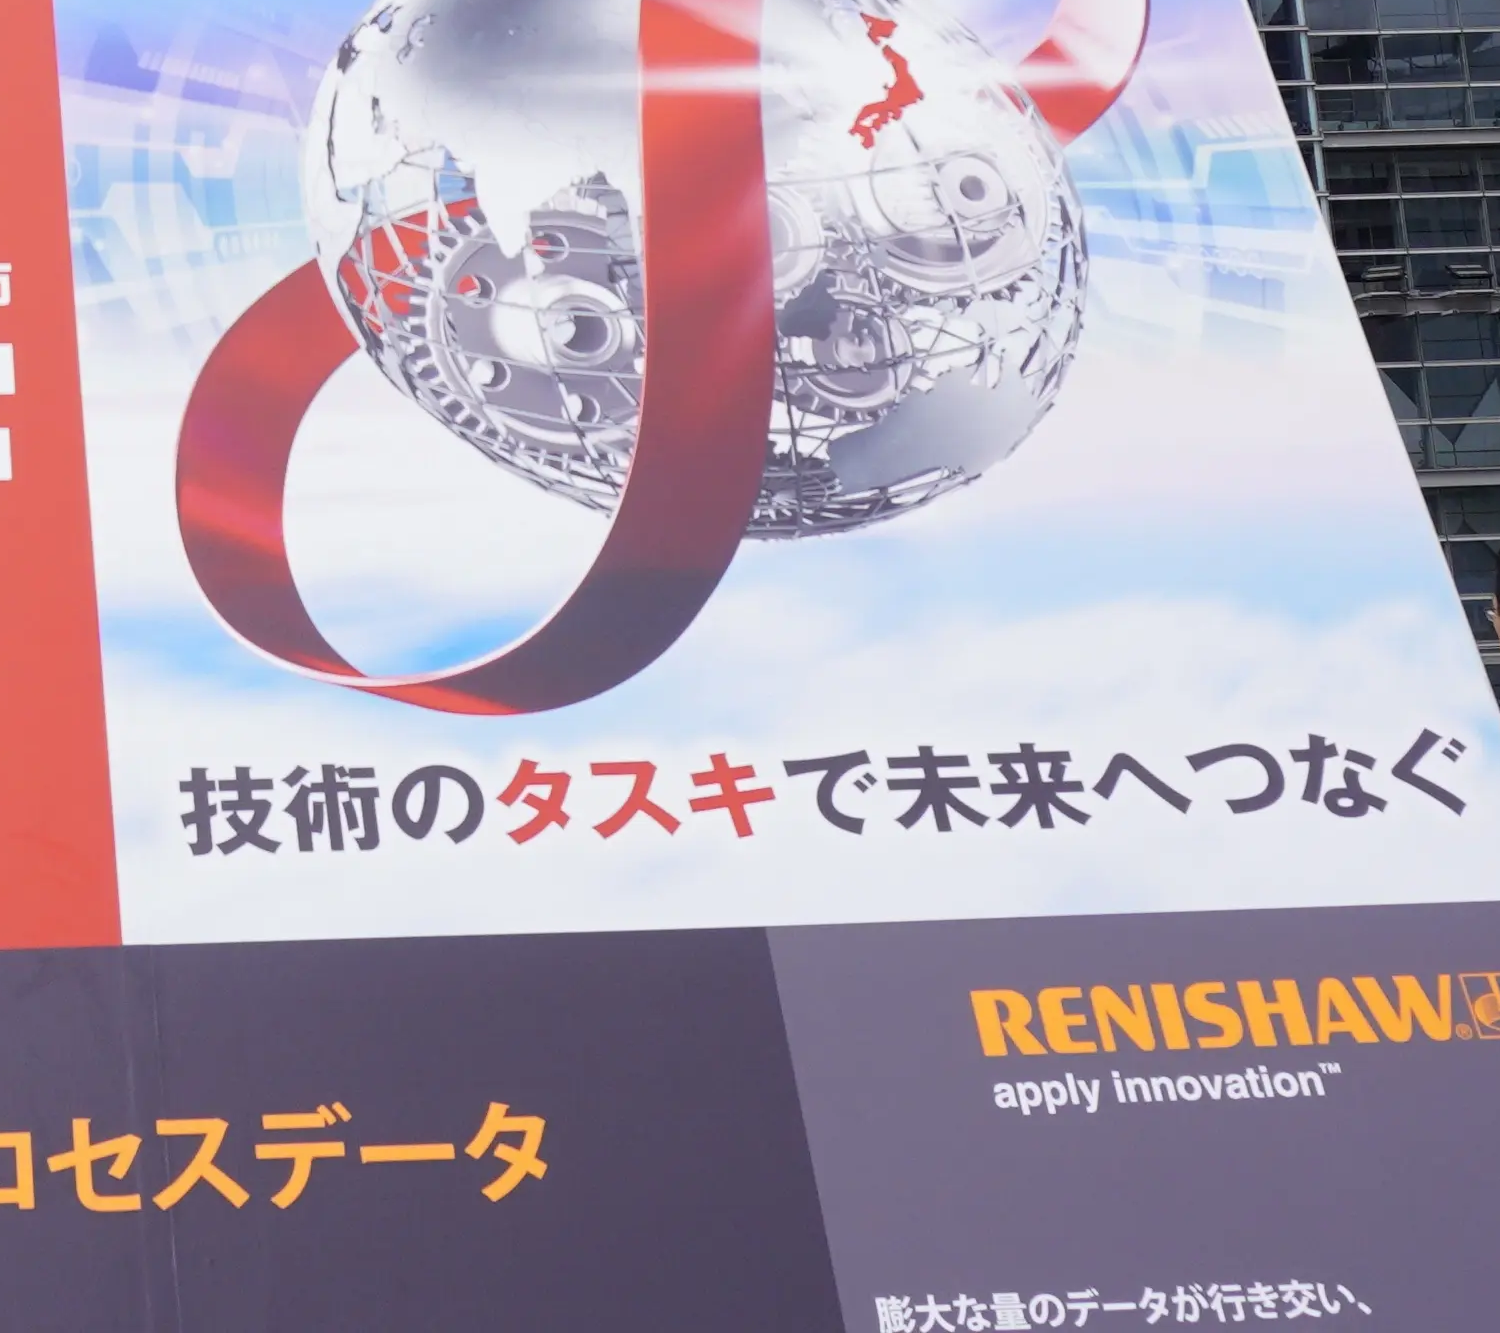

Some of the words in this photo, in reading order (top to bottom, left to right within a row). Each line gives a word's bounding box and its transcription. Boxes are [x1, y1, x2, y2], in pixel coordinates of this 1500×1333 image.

[179, 728, 1469, 858] 技術のタスキで未来へつなぐ
[993, 1072, 1101, 1117] apply
[873, 1279, 1375, 1333] 膨大な量のデータが行き交い、
